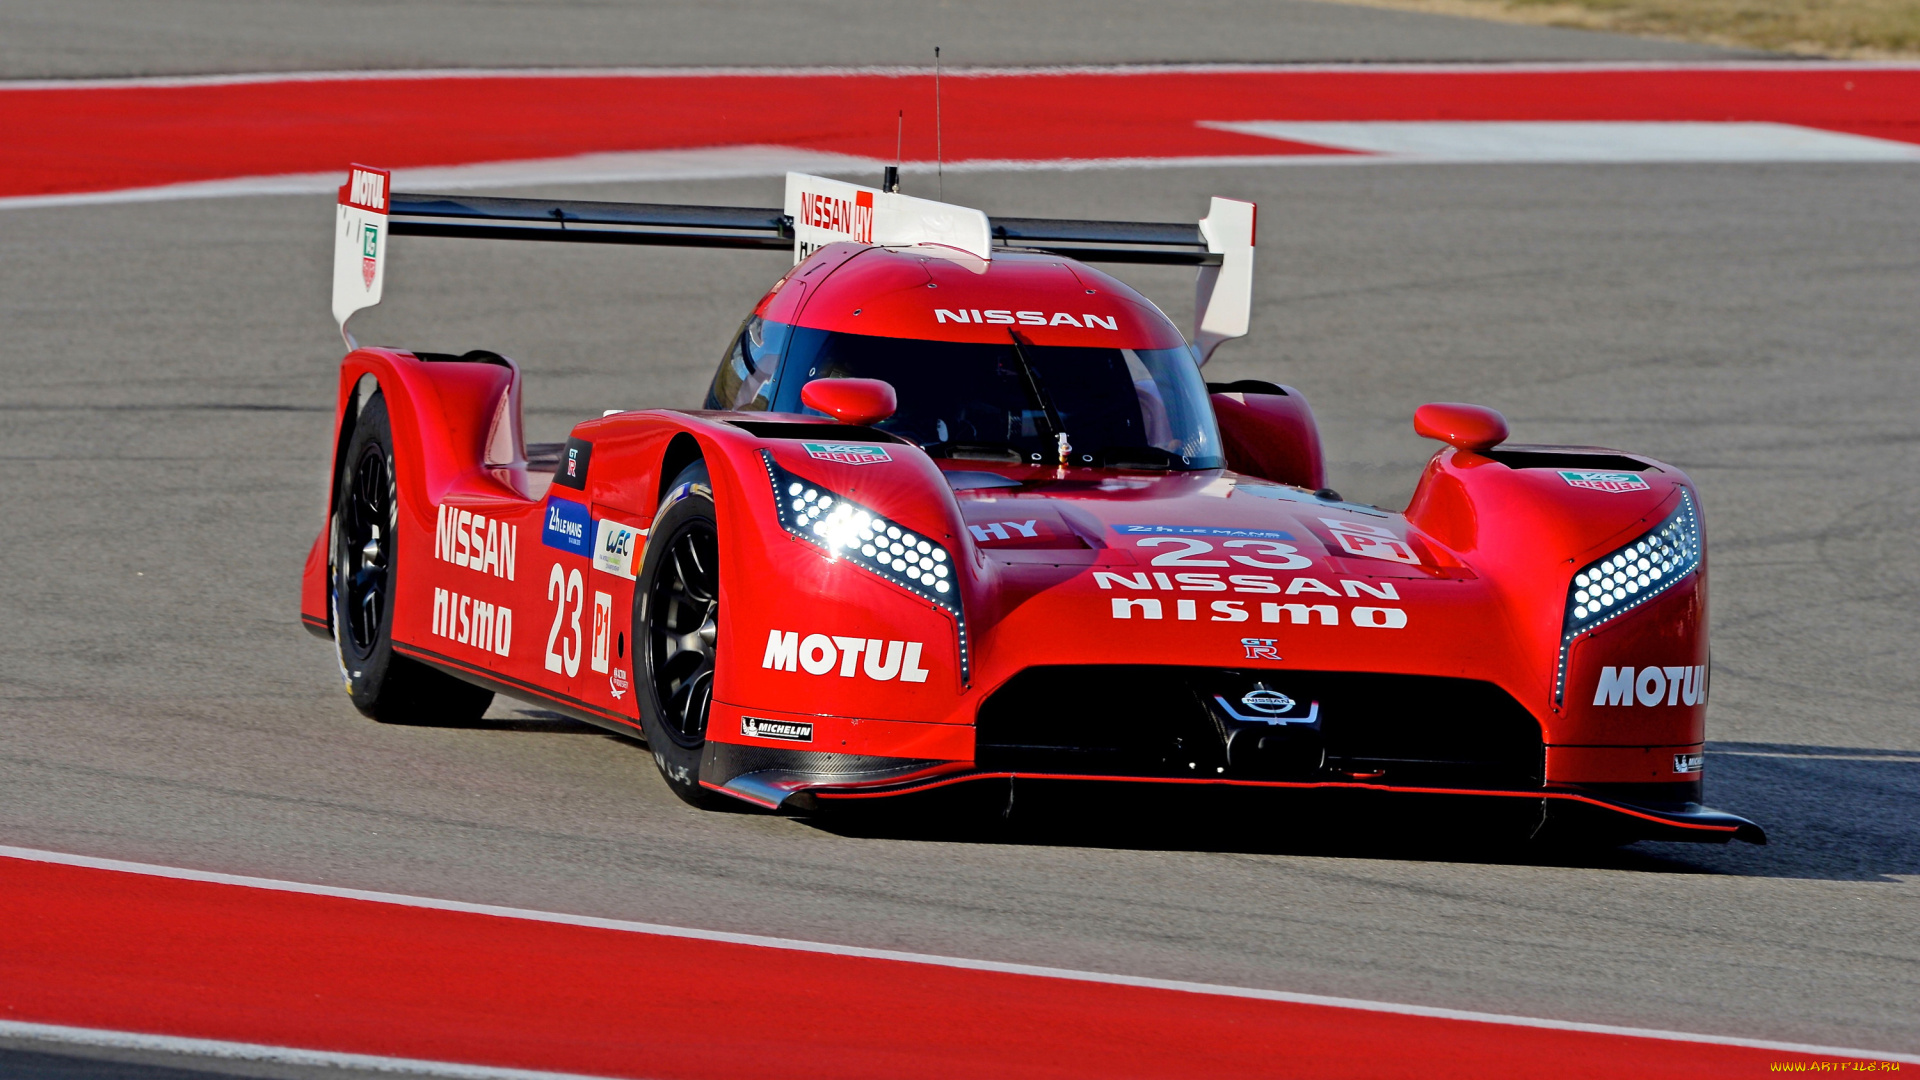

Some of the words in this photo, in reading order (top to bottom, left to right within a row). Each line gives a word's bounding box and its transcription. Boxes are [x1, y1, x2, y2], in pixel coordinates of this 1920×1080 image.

[350, 169, 385, 210] MOTUL
[801, 191, 851, 234] NISSAN
[855, 204, 873, 243] HY
[934, 309, 1119, 331] NISSAN
[569, 448, 578, 458] GT
[815, 453, 887, 463] HEUER
[567, 458, 577, 478] R
[1572, 481, 1644, 491] HEUER
[559, 519, 567, 535] LE
[566, 521, 583, 539] MANS
[967, 519, 1038, 542] HY
[1212, 529, 1281, 537] MANS
[434, 503, 517, 581] NISSAN
[606, 529, 631, 557] WEC
[1136, 537, 1312, 570] 23
[1347, 534, 1409, 560] P1
[1092, 571, 1401, 600] NISSAN
[545, 562, 584, 678] 23
[594, 603, 608, 661] P1
[1240, 638, 1278, 646] GT
[1243, 645, 1282, 660] R
[762, 629, 929, 683] MOTUL
[1592, 665, 1705, 707] MOTUL
[759, 722, 810, 736] MICHELIN
